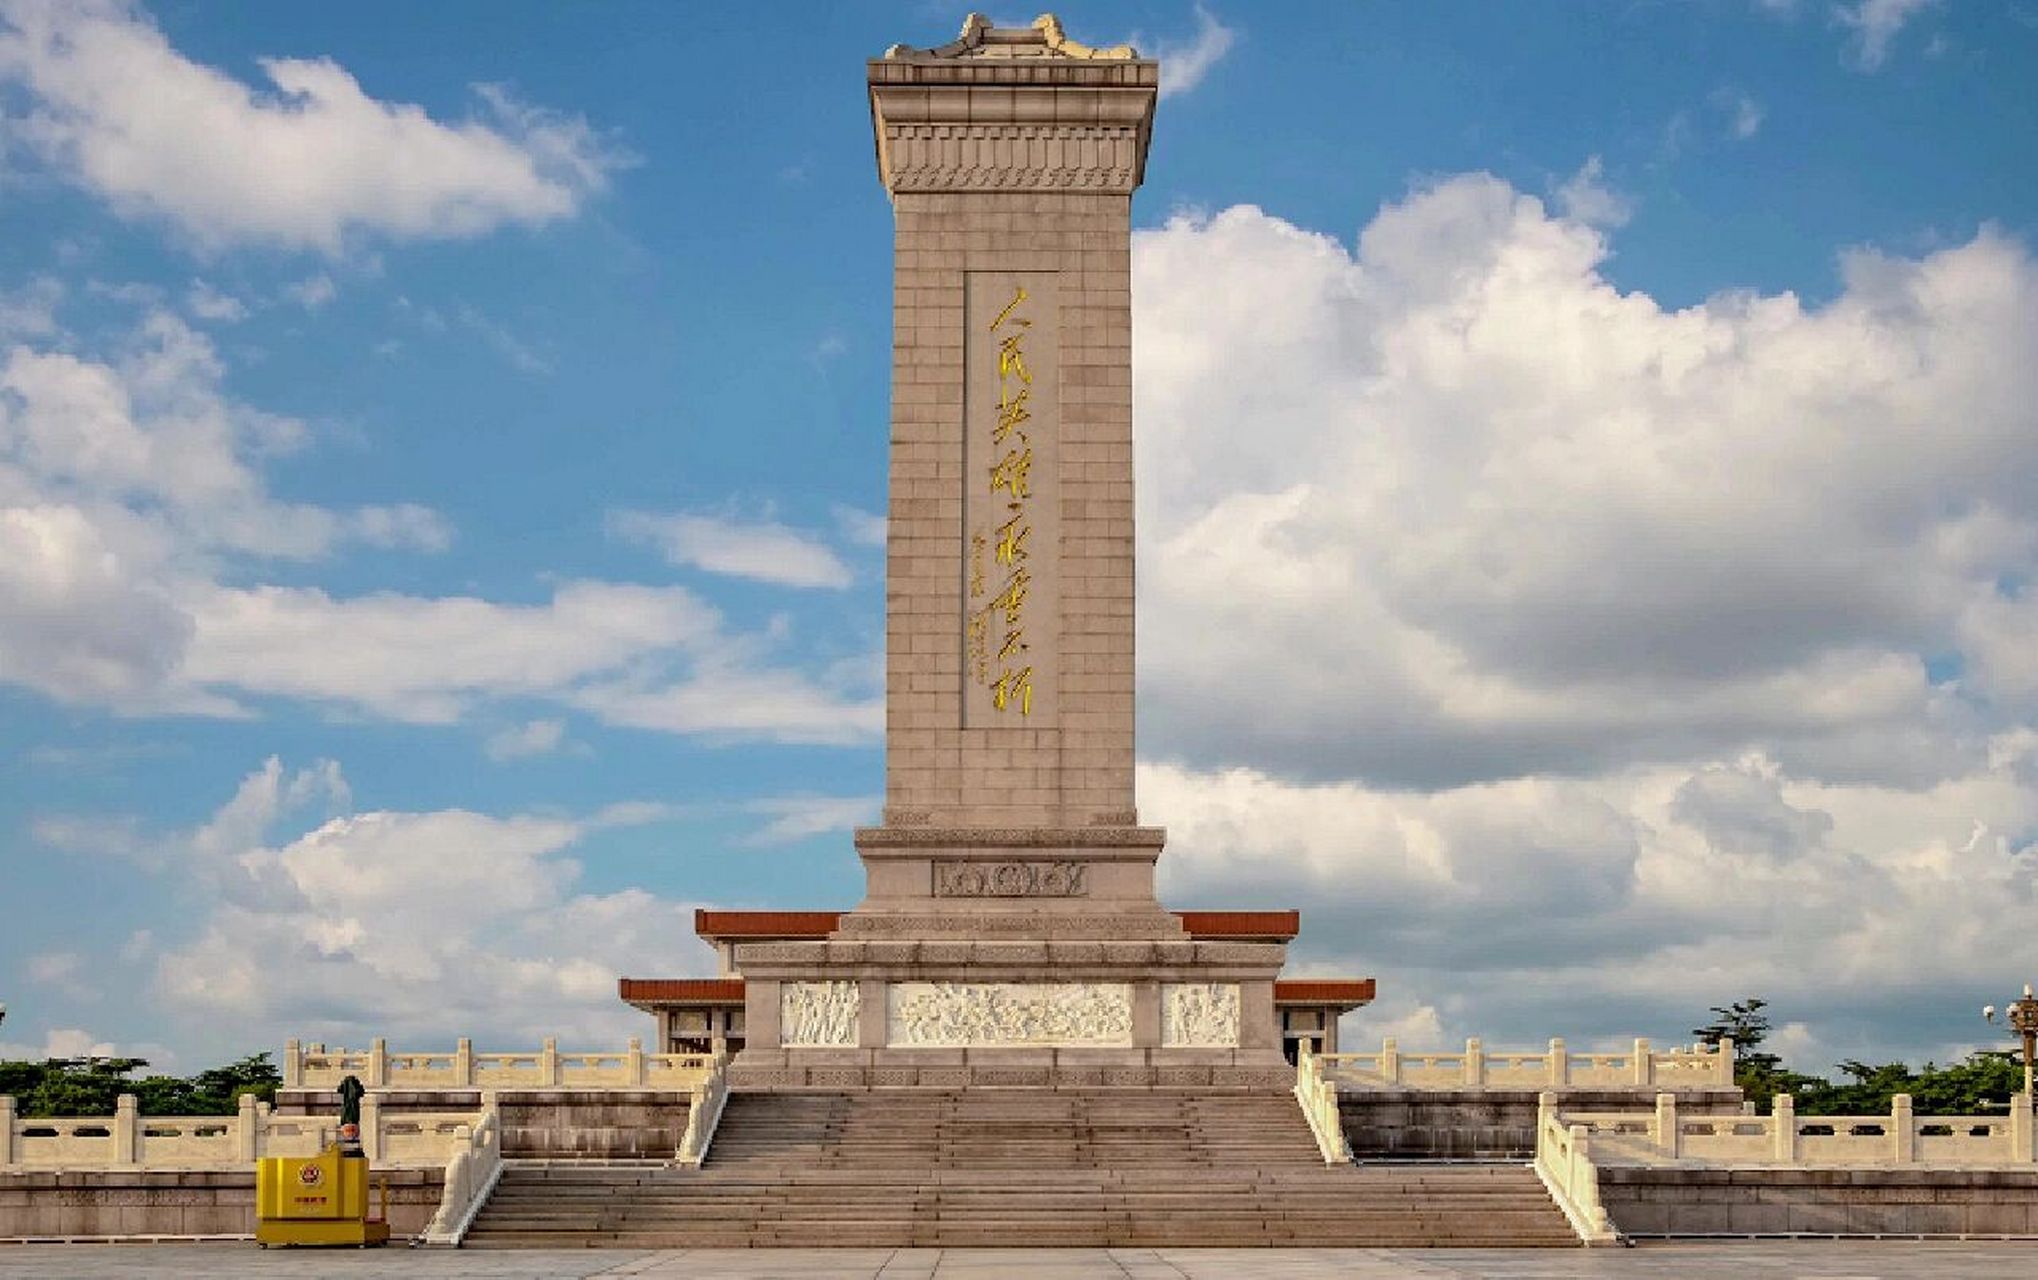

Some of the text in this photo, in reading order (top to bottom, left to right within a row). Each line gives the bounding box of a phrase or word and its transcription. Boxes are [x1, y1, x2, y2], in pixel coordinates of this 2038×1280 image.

[988, 286, 1033, 716] 人民英雄永垂不朽
